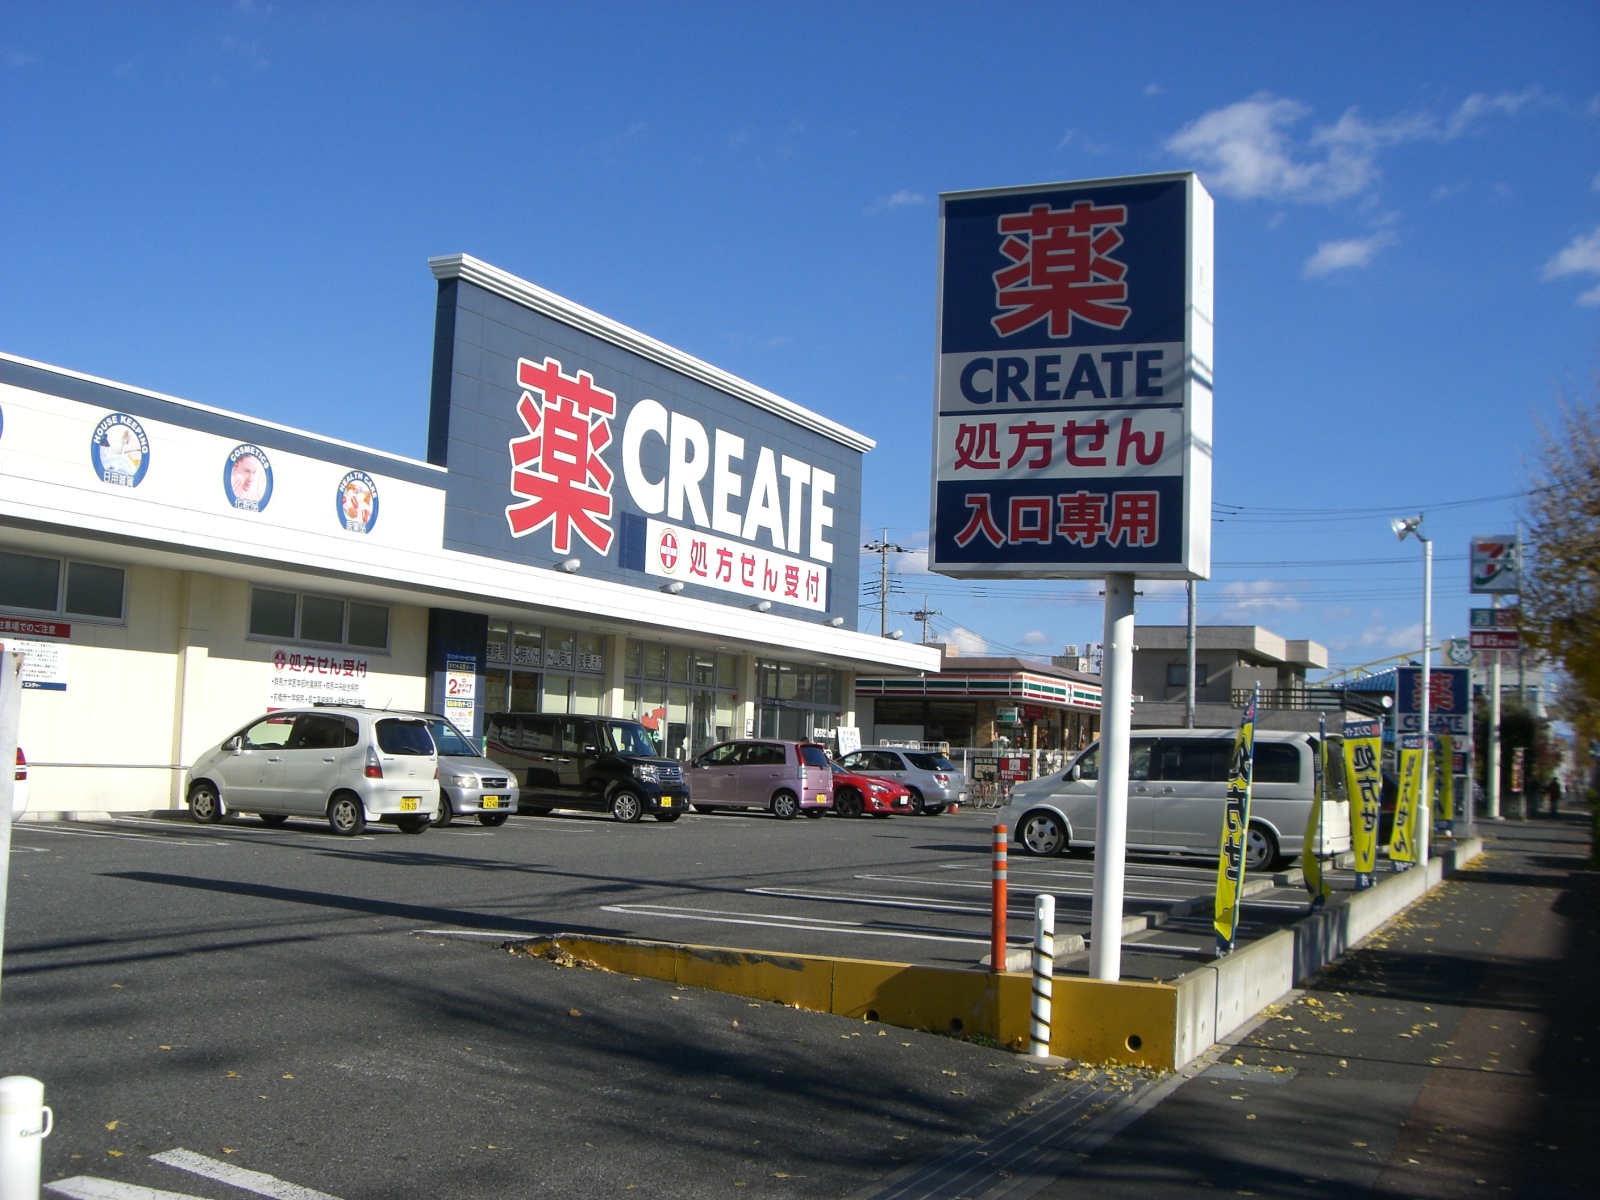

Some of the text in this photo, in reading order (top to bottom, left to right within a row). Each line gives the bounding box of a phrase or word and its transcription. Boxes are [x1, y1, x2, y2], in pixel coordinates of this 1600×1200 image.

[991, 200, 1132, 338] 薬
[960, 349, 1164, 405] CREATE
[93, 414, 149, 455] HOUSE KEEPING
[229, 446, 270, 470] COSMETICS
[505, 356, 616, 557] 薬
[954, 417, 1165, 471] 処方せん
[338, 471, 378, 499] HEALTH CARE
[622, 398, 836, 564] CREATE
[954, 489, 1160, 549] 入口専用
[689, 538, 820, 603] 処方せん受付
[288, 652, 368, 679] 処方せん受付
